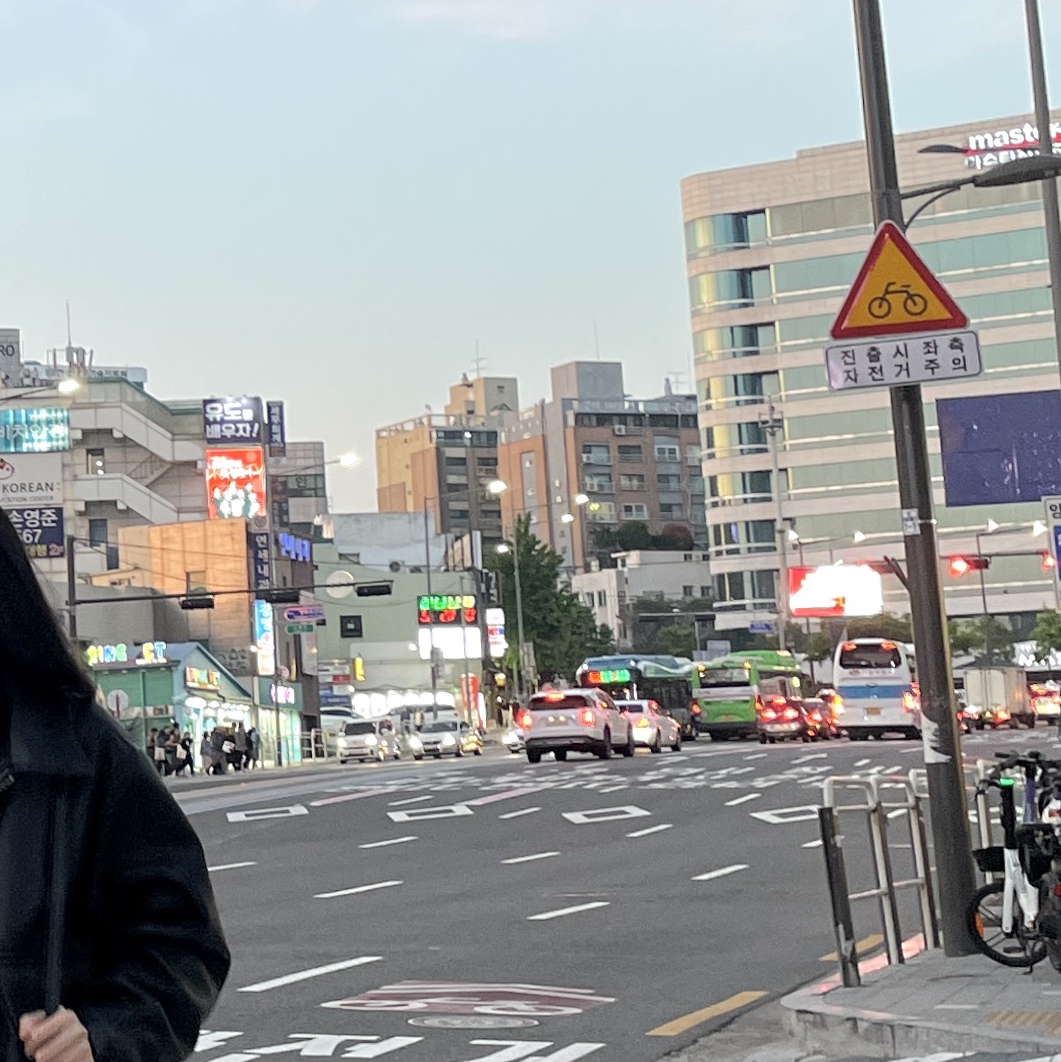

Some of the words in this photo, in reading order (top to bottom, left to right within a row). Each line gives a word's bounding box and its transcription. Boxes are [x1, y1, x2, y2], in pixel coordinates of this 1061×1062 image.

[922, 336, 965, 356] 좌측
[842, 361, 912, 384] 자전거
[924, 354, 968, 376] 주의
[205, 423, 260, 439] 배우자!
[2, 481, 54, 494] KOREAN
